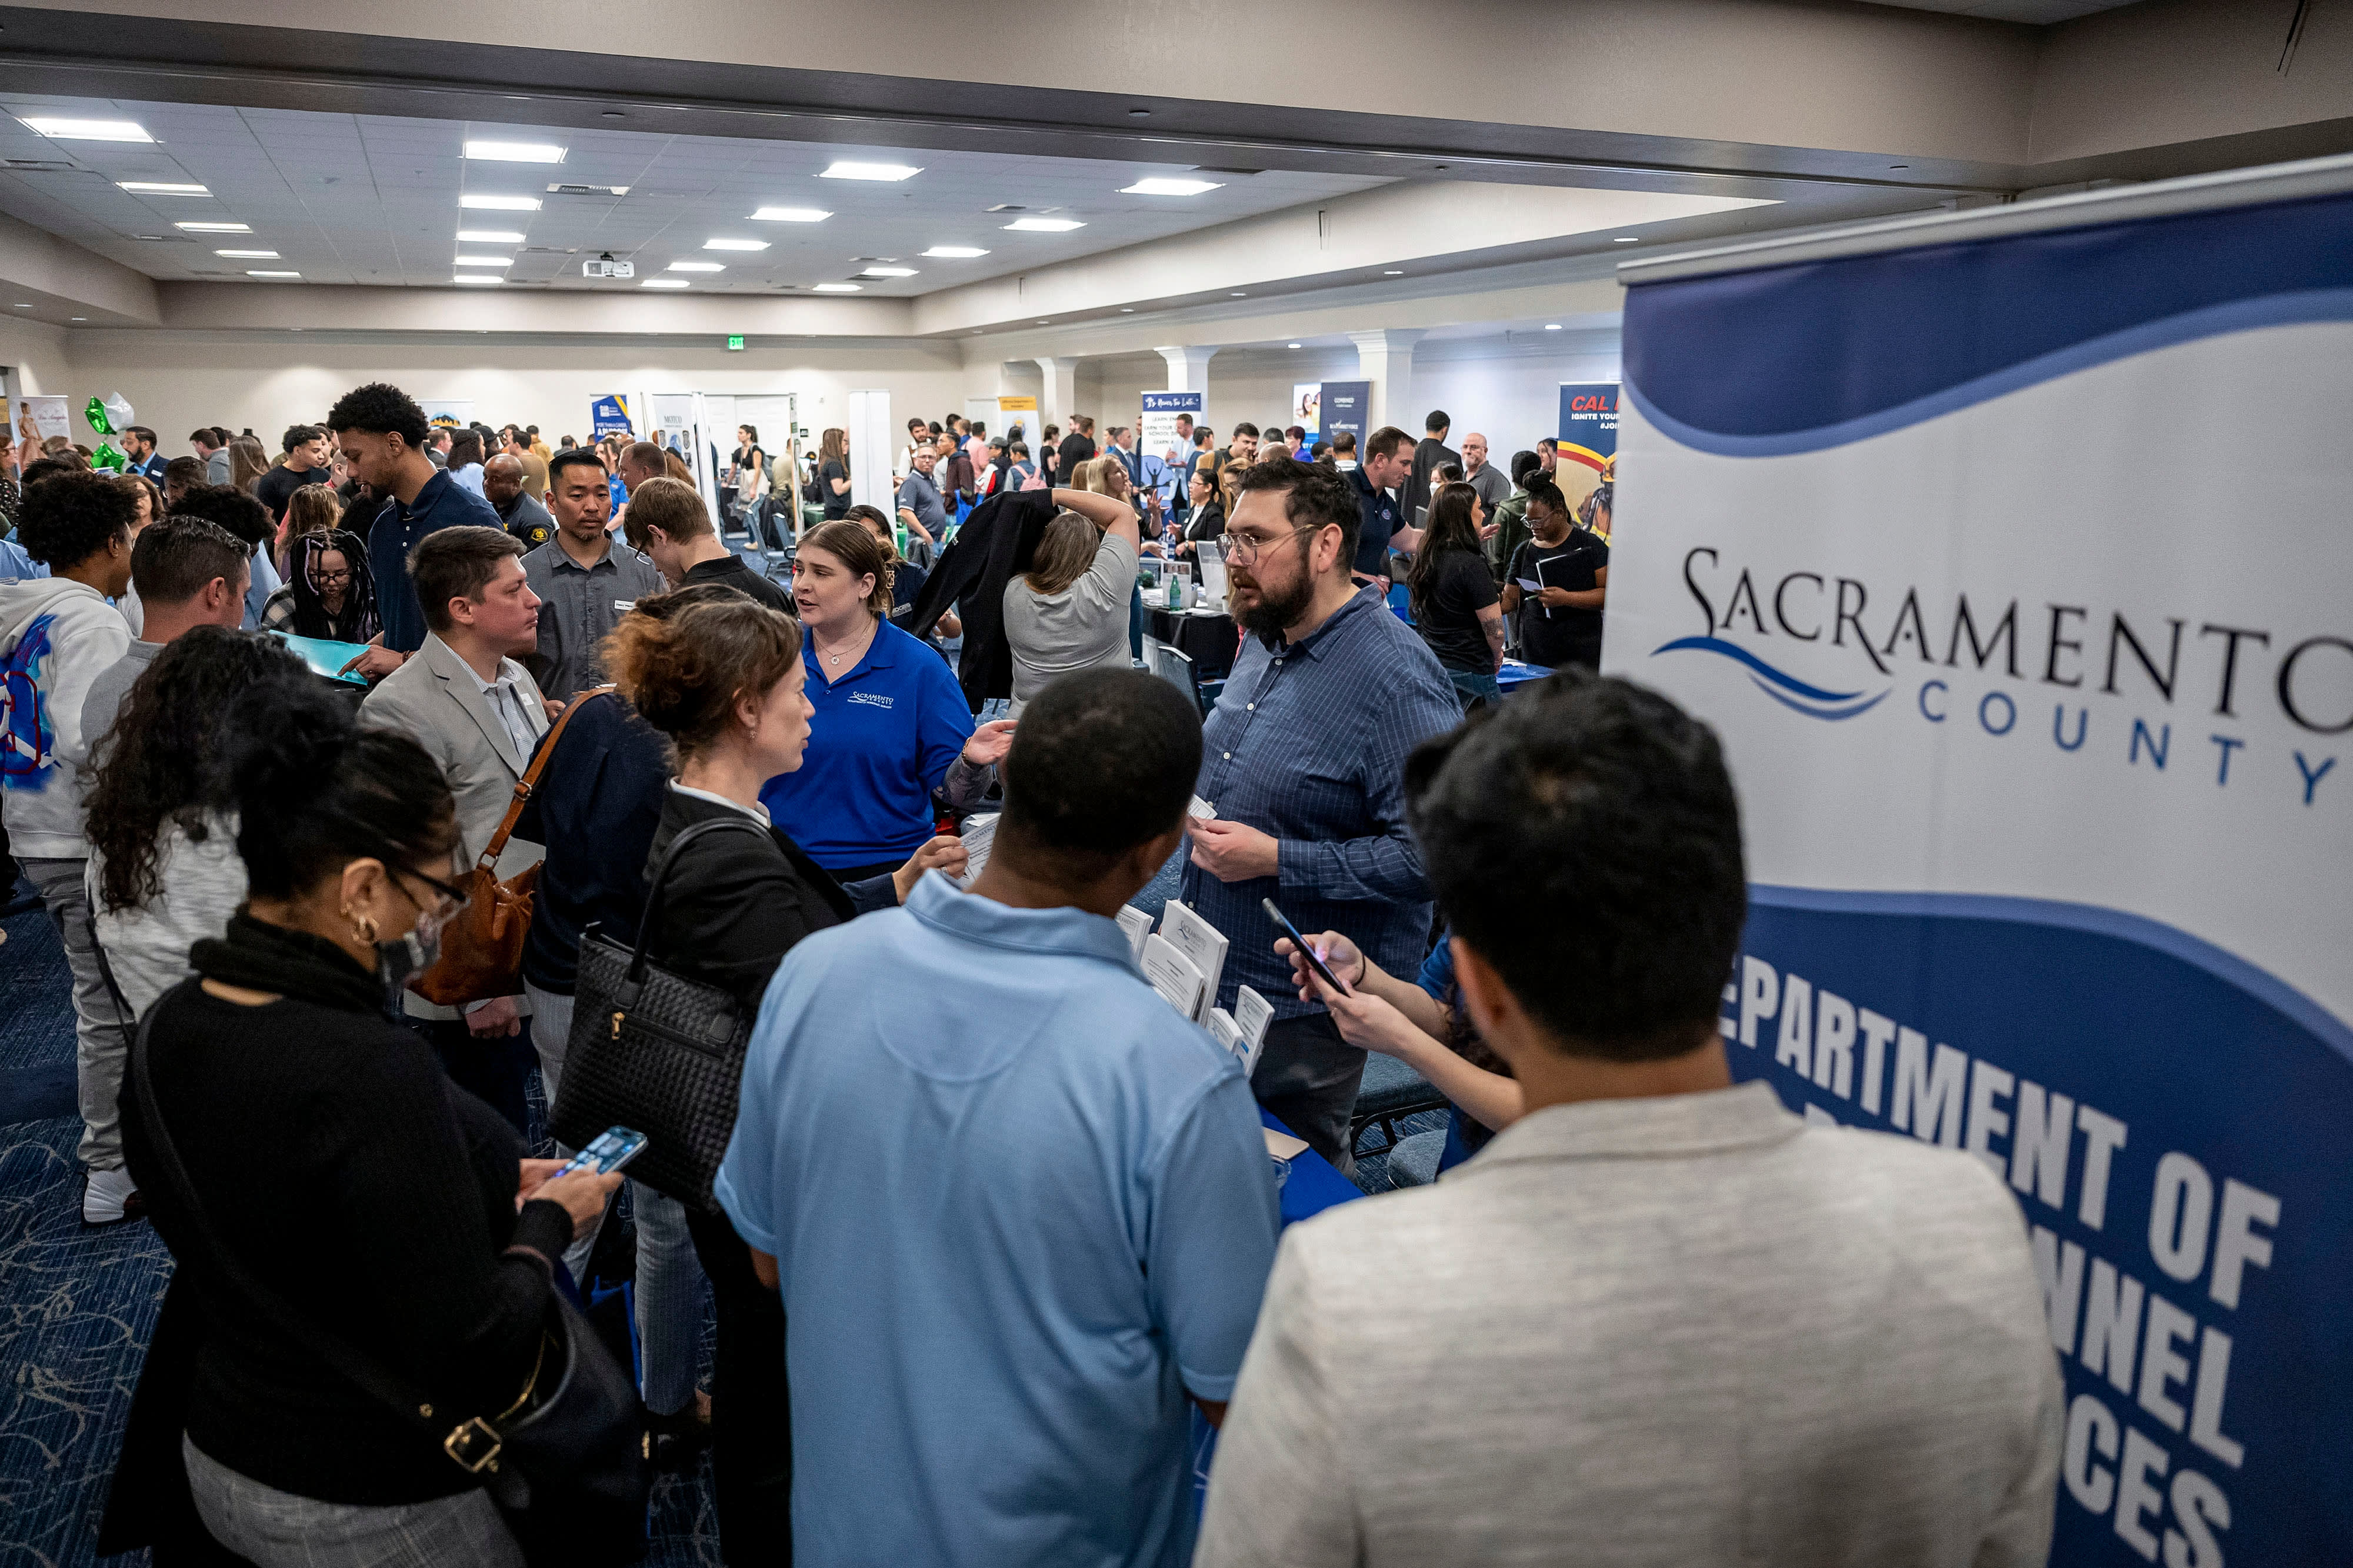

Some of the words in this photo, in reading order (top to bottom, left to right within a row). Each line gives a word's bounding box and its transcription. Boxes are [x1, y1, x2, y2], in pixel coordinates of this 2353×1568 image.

[1571, 395, 1609, 411] CAL
[853, 691, 894, 702] SACRAMENTO
[1682, 547, 2353, 735] SACRAMENTO
[1918, 680, 2336, 806] COUNTY
[1718, 953, 2128, 1232] PARTMENT
[2148, 1151, 2282, 1310] OF
[2031, 1223, 2245, 1469] NNEL
[2063, 1394, 2234, 1568] CES
